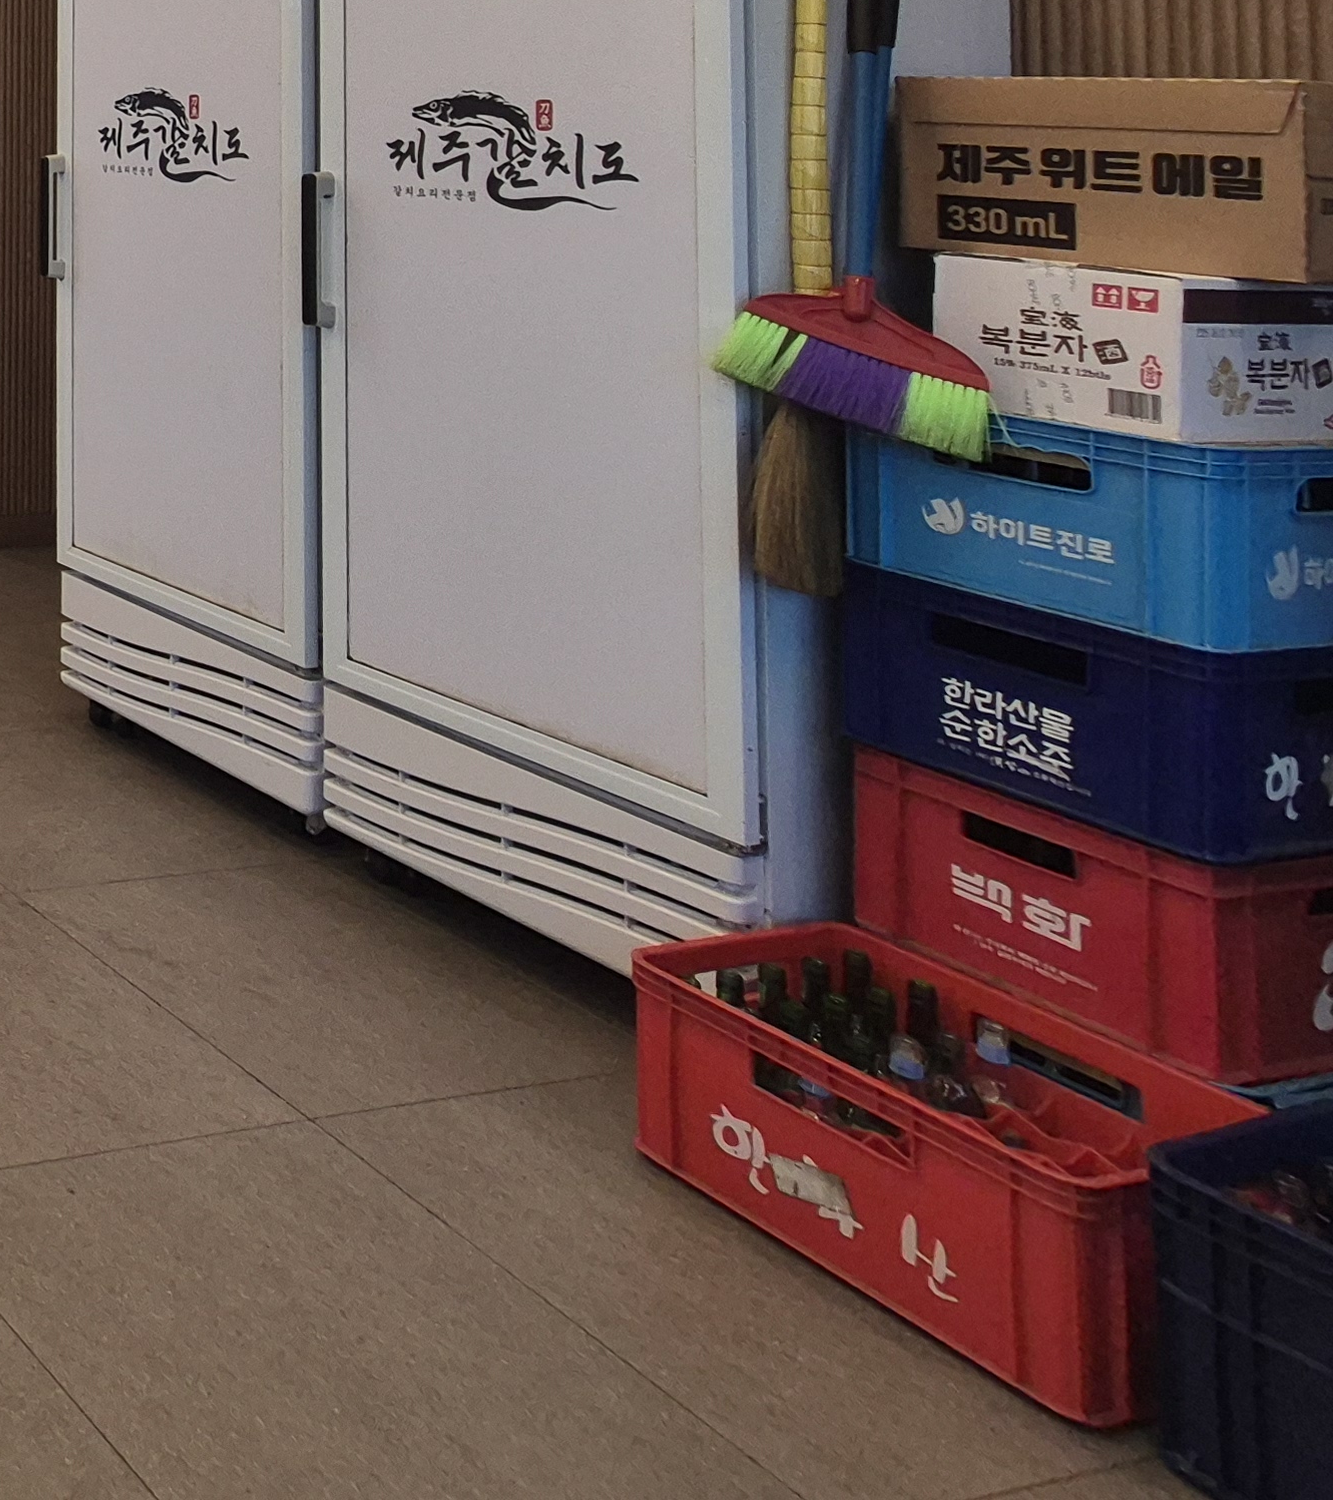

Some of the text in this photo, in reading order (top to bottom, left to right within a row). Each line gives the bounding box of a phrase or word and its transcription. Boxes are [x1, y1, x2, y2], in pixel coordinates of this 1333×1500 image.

[97, 117, 250, 167] 제주갈치도
[385, 127, 640, 190] 제주갈치도
[392, 185, 478, 202] 갈치요리전문점
[936, 142, 1264, 201] 제주 위트 에일
[945, 204, 1069, 240] 330 mL
[978, 323, 1088, 363] 복분자
[993, 356, 1016, 368] 15%
[1019, 360, 1059, 374] 375mL
[1245, 357, 1311, 391] 복분자
[969, 511, 1116, 565] 하이트진로
[940, 677, 1075, 744] 한라산물
[938, 708, 1075, 772] 순한소주
[709, 1102, 959, 1303] 한산
